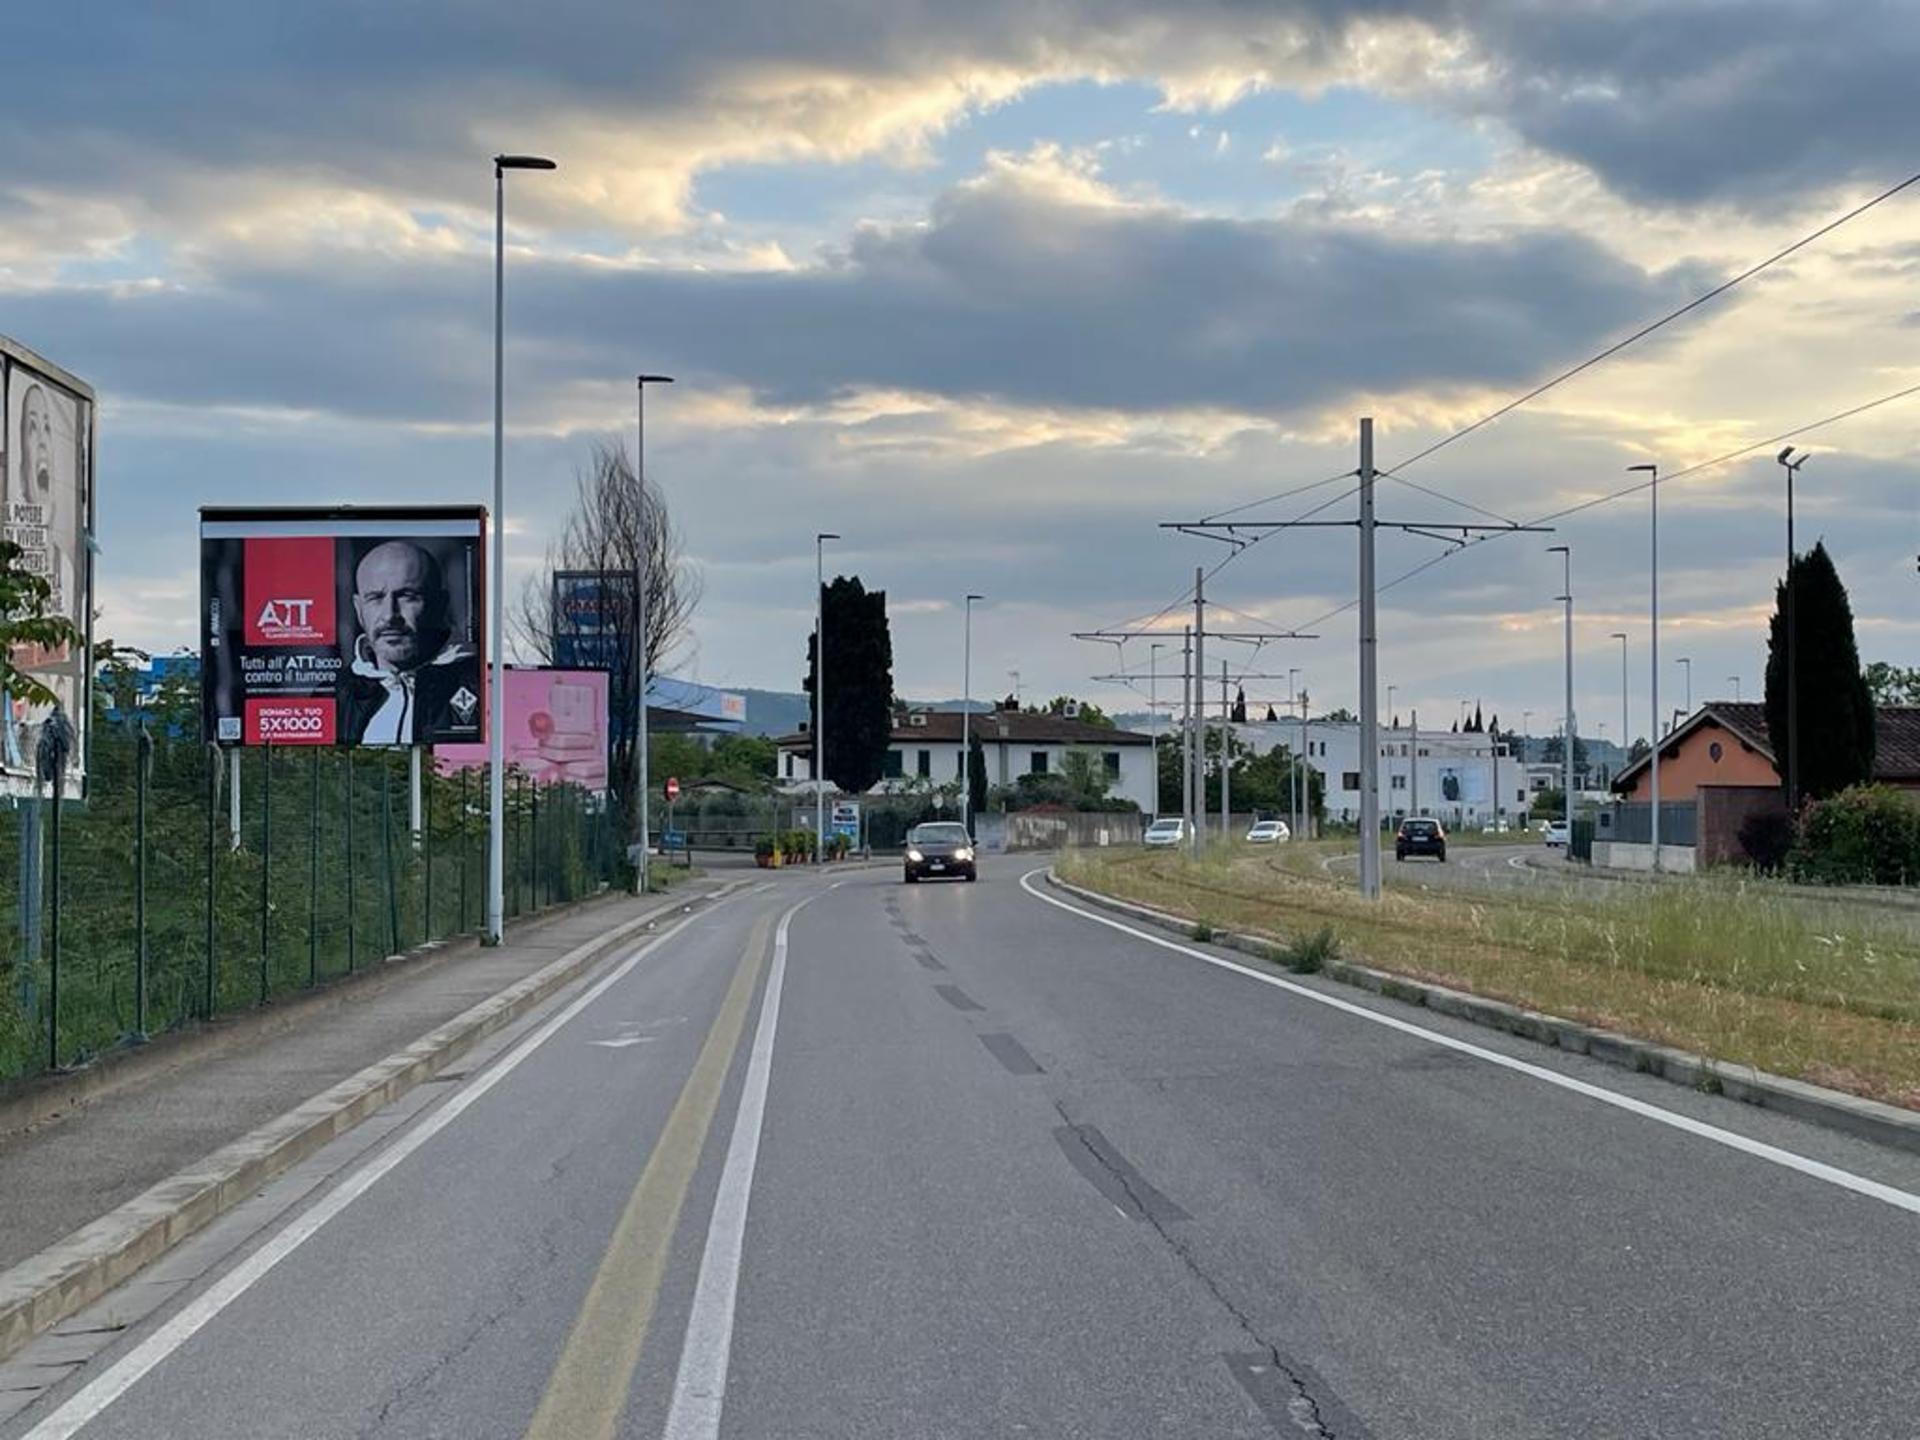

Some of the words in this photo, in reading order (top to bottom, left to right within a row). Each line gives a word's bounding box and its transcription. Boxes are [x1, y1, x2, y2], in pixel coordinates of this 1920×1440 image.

[256, 599, 313, 627] ATT
[240, 655, 265, 670] Tutti
[245, 671, 282, 683] contro
[285, 669, 293, 682] il
[295, 671, 336, 682] tumore
[259, 717, 322, 731] 5X1000
